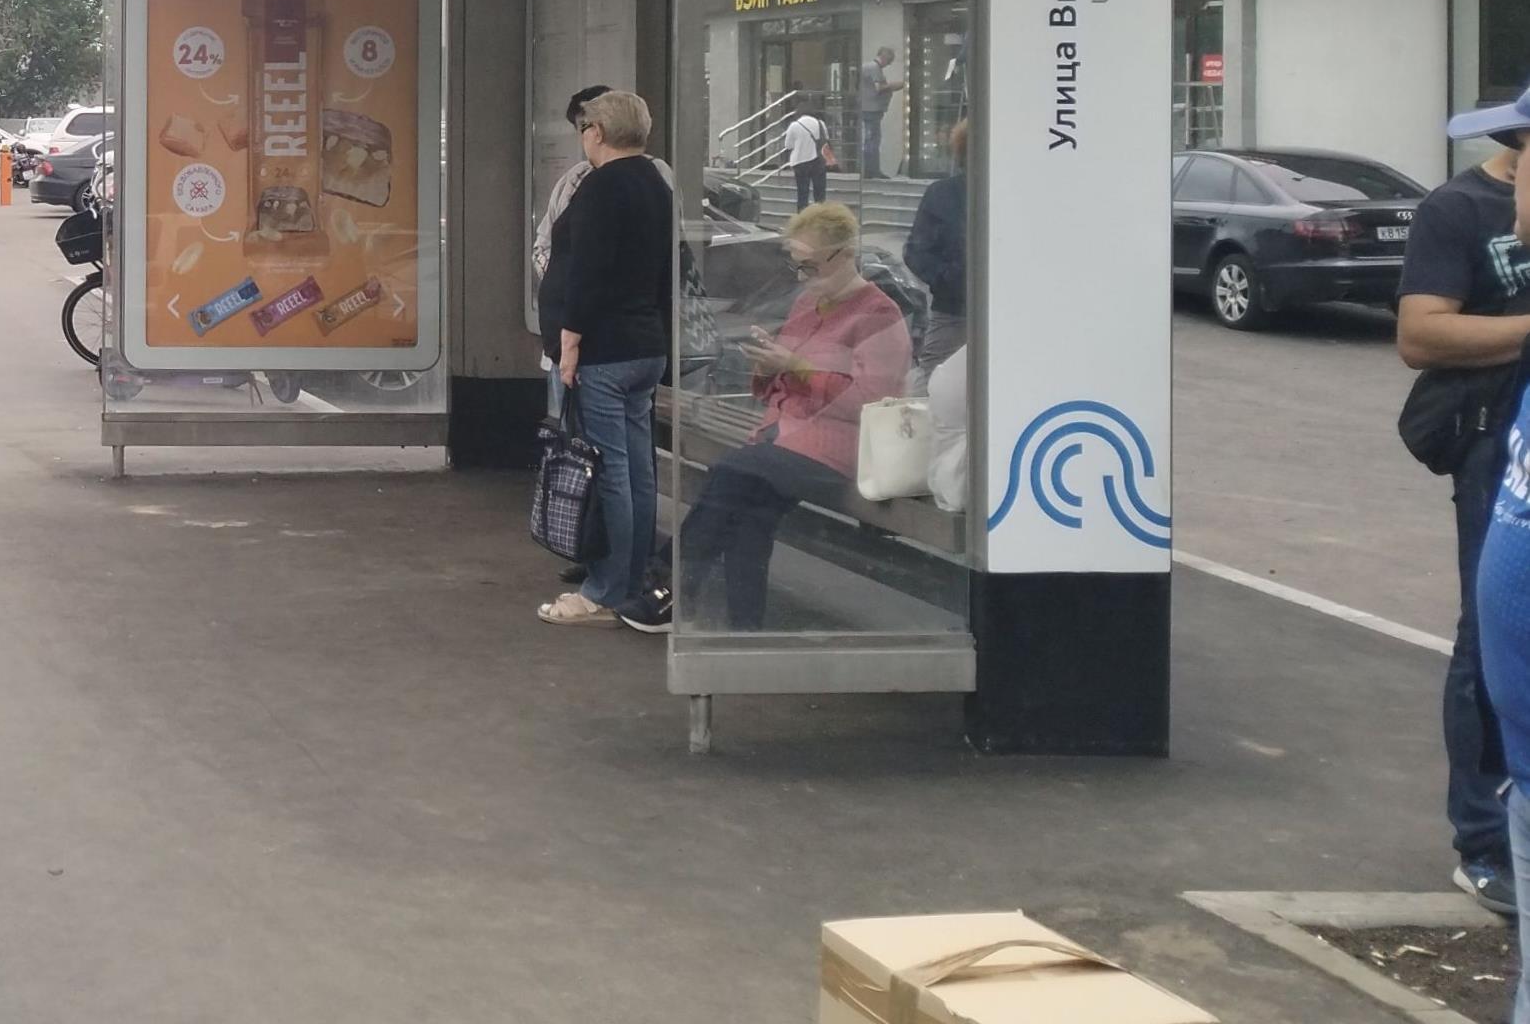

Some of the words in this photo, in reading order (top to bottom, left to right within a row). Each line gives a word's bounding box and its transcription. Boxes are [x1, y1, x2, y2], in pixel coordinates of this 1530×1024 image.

[178, 43, 222, 65] 24%
[361, 39, 378, 63] 8
[264, 51, 307, 157] REEEL
[1048, 41, 1081, 151] Улица
